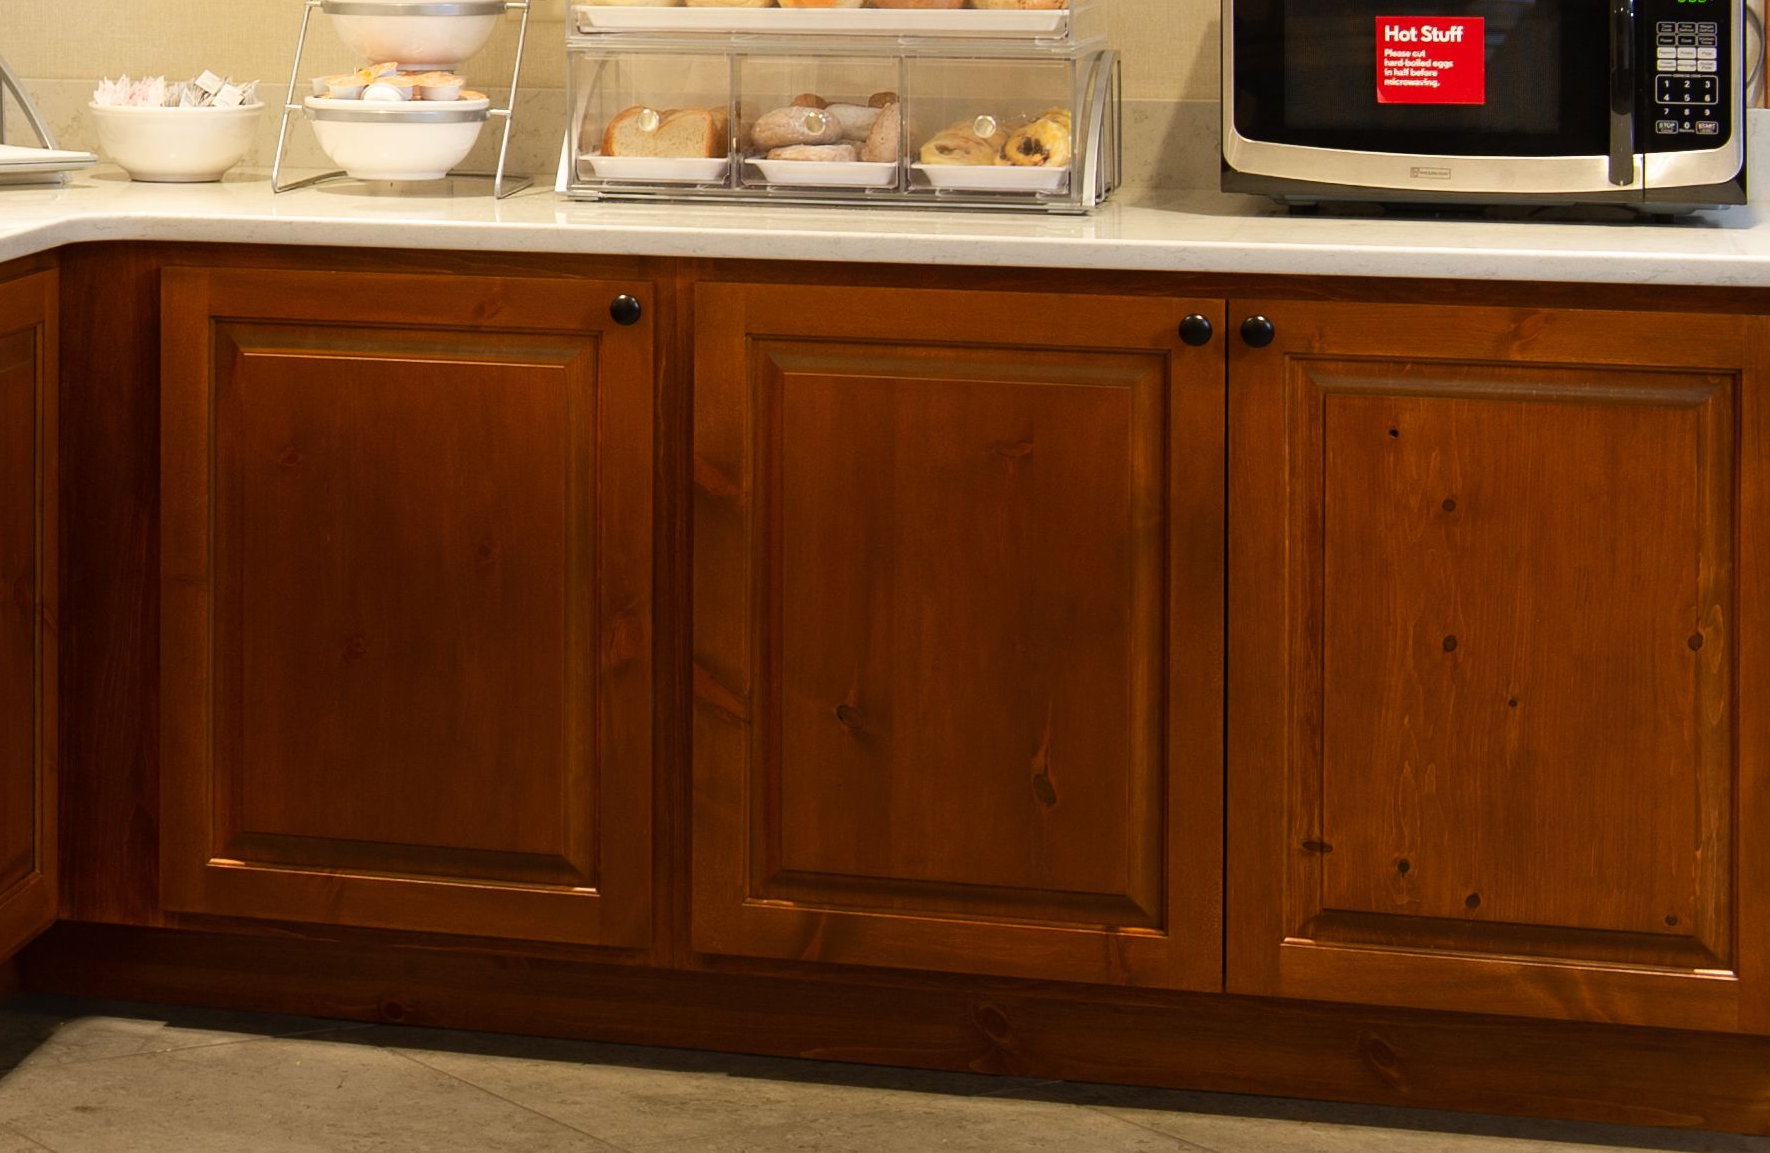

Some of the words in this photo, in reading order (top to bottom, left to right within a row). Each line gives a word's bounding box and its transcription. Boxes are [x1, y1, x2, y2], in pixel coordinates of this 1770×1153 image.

[1384, 25, 1417, 42] Hot
[1421, 25, 1464, 42] Stuff
[1384, 48, 1411, 57] Please
[1384, 58, 1432, 67] hard-boiled
[1432, 60, 1454, 69] eggs
[1384, 68, 1393, 76] in
[1393, 68, 1409, 76] half
[1410, 68, 1438, 77] before
[1384, 77, 1441, 88] microwaving.
[1664, 80, 1669, 88] 1
[1684, 80, 1690, 88] 2
[1704, 80, 1710, 88] 3
[1663, 93, 1670, 101] 4
[1684, 94, 1690, 102] 5
[1704, 94, 1711, 102] 6
[1684, 108, 1690, 116] 8
[1684, 121, 1690, 129] 0
